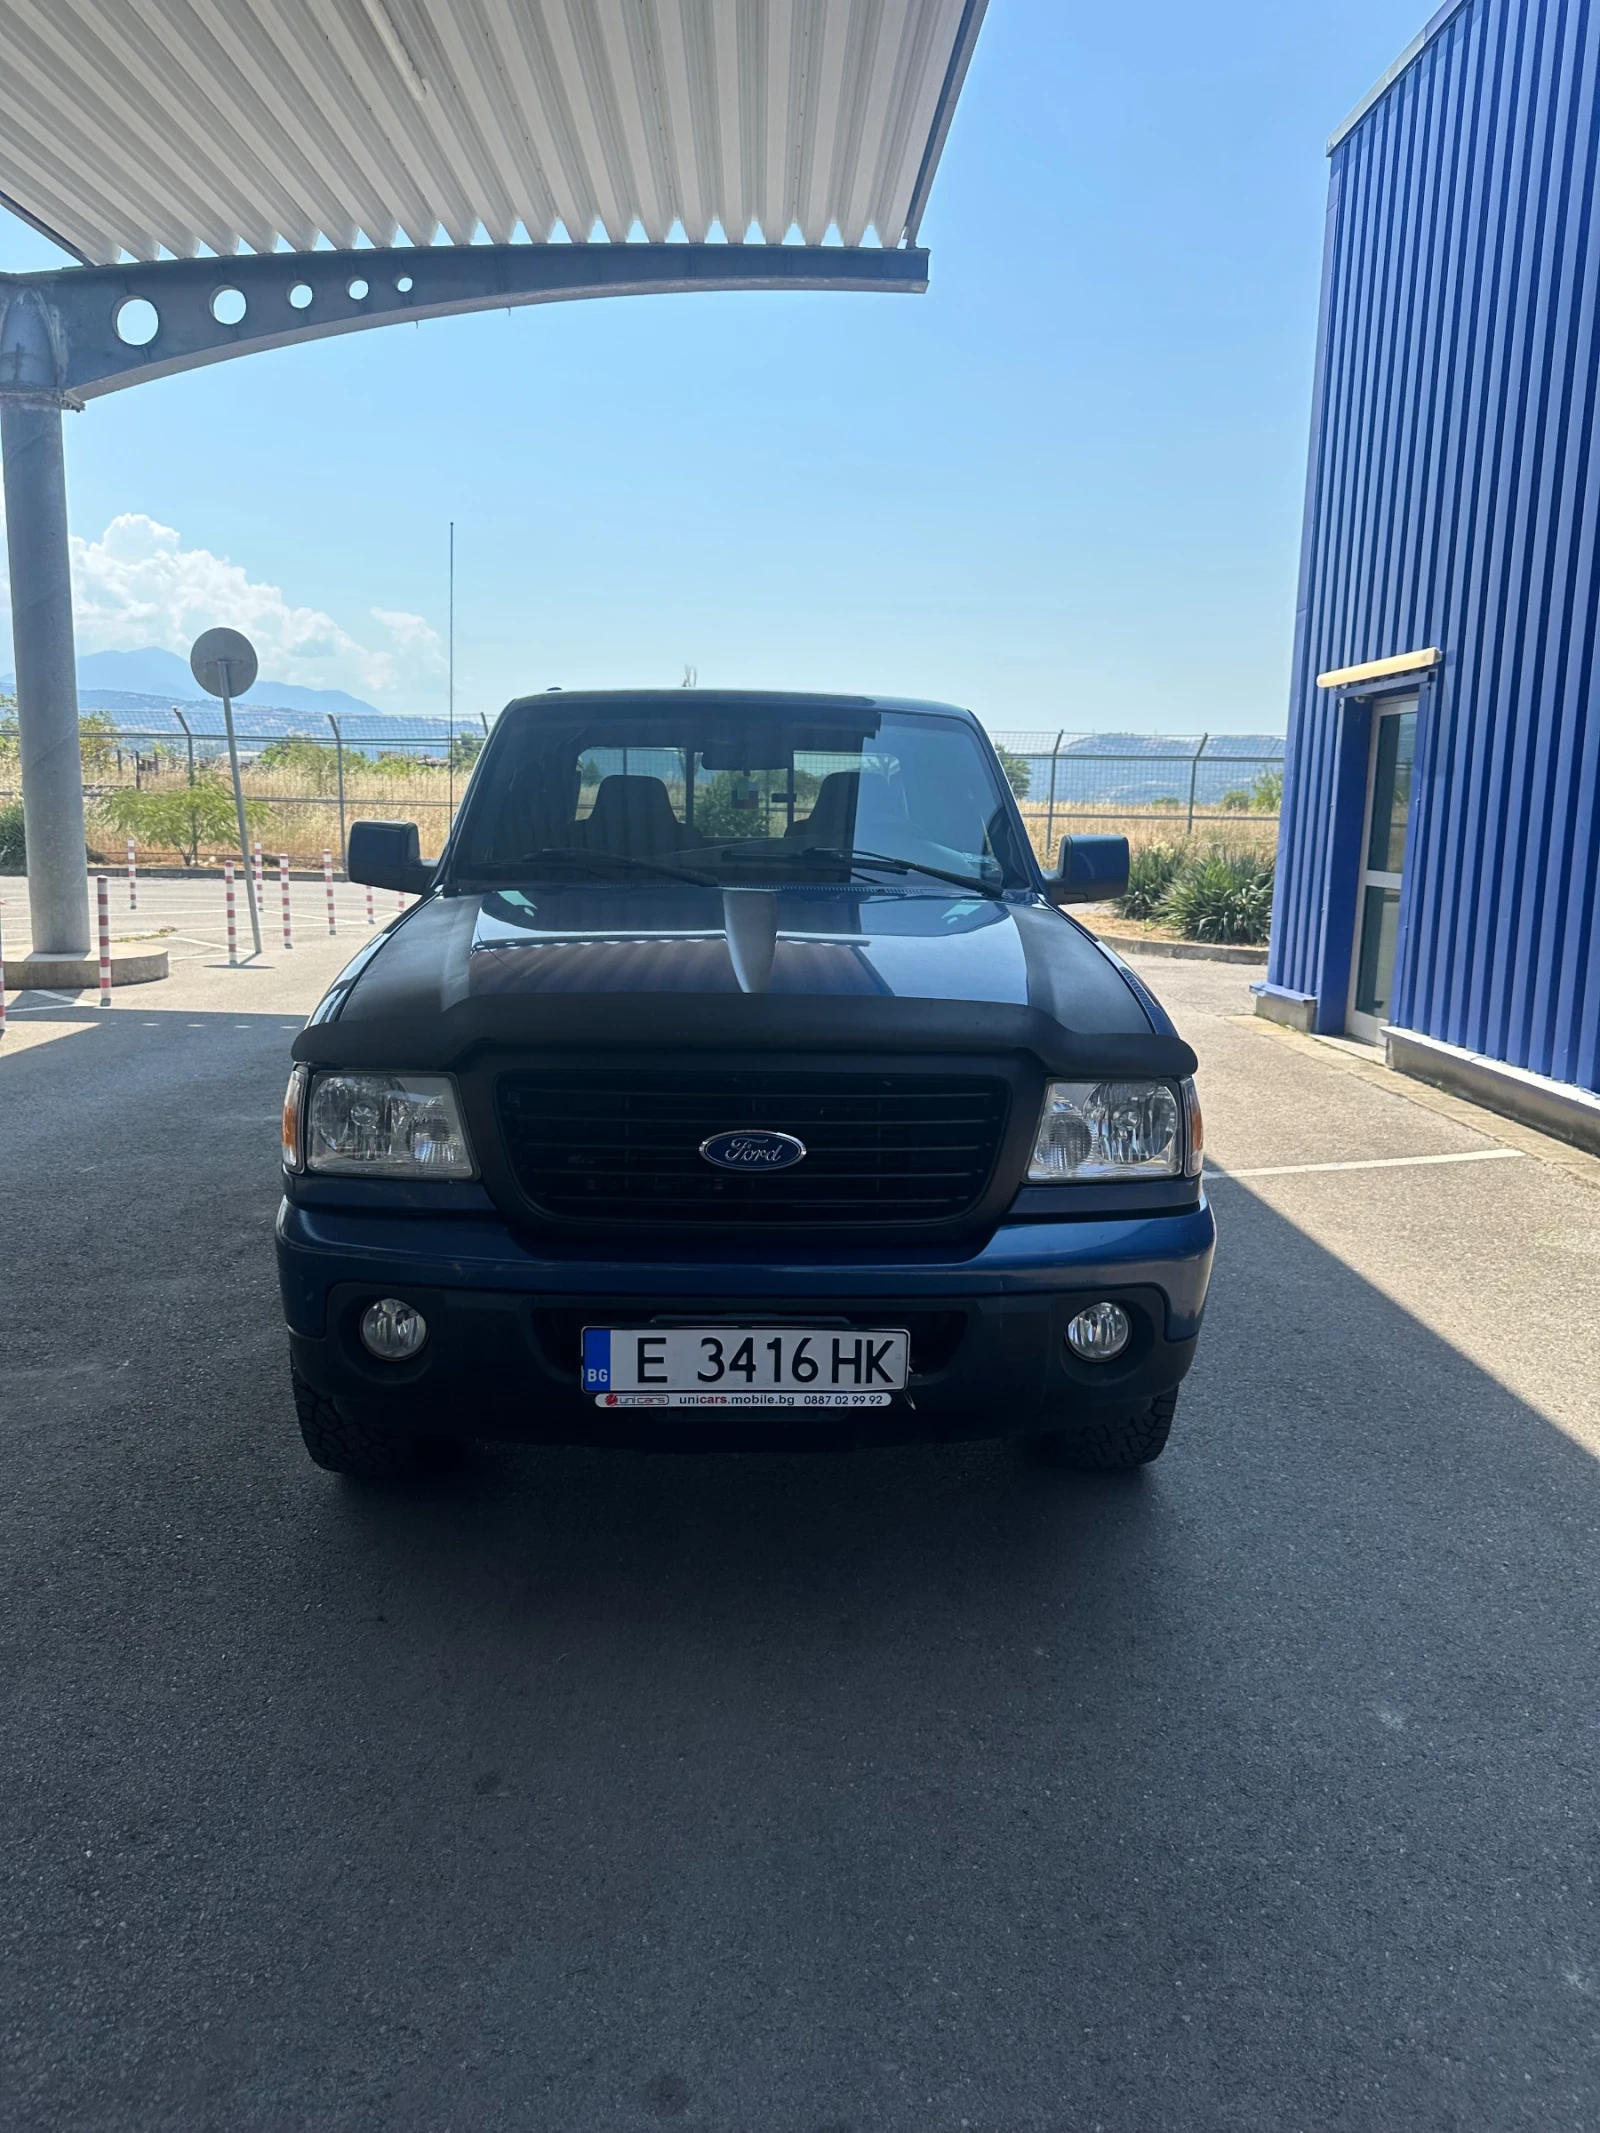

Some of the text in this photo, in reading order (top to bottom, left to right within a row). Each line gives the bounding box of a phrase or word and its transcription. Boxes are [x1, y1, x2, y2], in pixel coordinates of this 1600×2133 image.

[725, 1137, 783, 1162] Ford
[637, 1337, 896, 1384] E 3416 HK
[587, 1368, 608, 1382] BG
[679, 1394, 883, 1406] unicars.mobile.bg 0887 02 99 92
